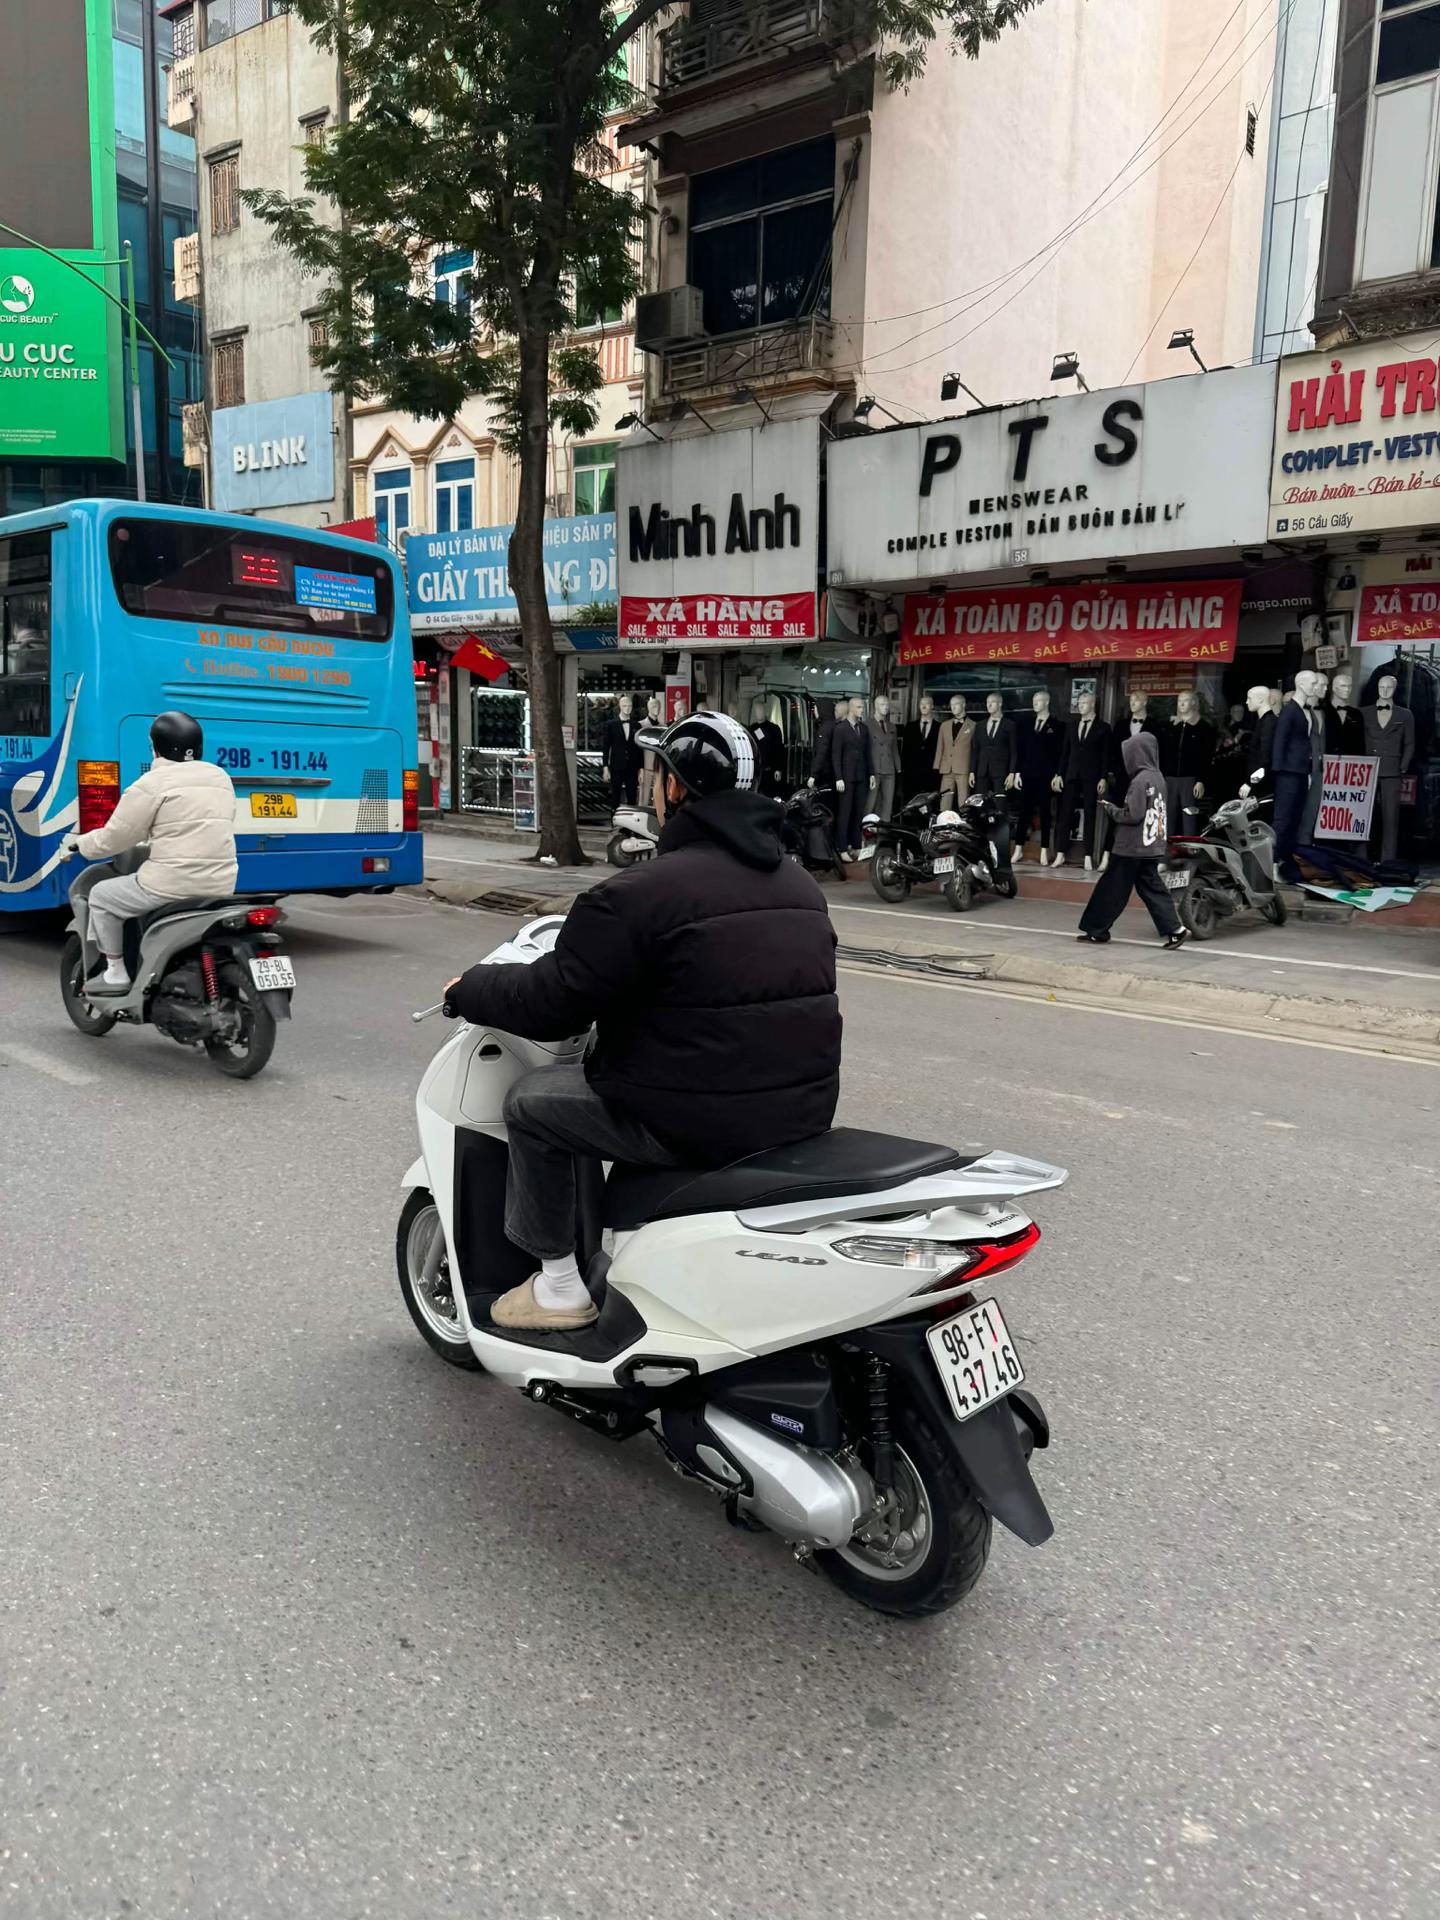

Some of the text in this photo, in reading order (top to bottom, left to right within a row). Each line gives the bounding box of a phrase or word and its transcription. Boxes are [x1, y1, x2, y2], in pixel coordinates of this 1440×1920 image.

[23, 343, 75, 364] CUC
[43, 368, 97, 380] CENTER
[1287, 356, 1440, 432] HẢI TR
[233, 435, 307, 474] BLINK
[969, 484, 1089, 515] MENSWEAR
[1283, 486, 1318, 504] Bán
[1319, 483, 1356, 501] buôn
[1367, 476, 1405, 495] Bán
[573, 520, 600, 543] SẢN
[629, 492, 801, 562] Minh Anh
[887, 531, 948, 553] COMPLE
[956, 522, 1013, 546] VESTON
[1027, 513, 1060, 536] BÁN
[1121, 502, 1156, 526] BÁN
[1292, 512, 1354, 531] 56 Cầu Giấy
[428, 541, 446, 560] ĐẠI
[449, 537, 461, 556] LÝ
[464, 534, 488, 554] BÁN
[490, 531, 505, 551] VÀ
[1014, 550, 1028, 563] 58
[417, 560, 469, 604] GIẦY
[646, 596, 785, 623] XẢ HÀNG
[1372, 587, 1440, 614] XẢ TO
[914, 589, 1224, 638] XẢ TOÀN BỘ CỬA HÀNG
[627, 622, 806, 637] SALE SALE SALE SALE SALE SALE
[1369, 619, 1433, 637] SALE SALE
[903, 641, 1229, 661] SALE SALE SALE SALE SALE SALE SALE
[217, 747, 251, 769] 29B
[271, 749, 328, 771] 191.44
[1343, 762, 1373, 787] VEST
[263, 794, 283, 805] 29B
[1323, 789, 1368, 803] NAM NỮ
[258, 805, 293, 817] 191.44
[257, 972, 295, 988] 050.55
[735, 1249, 829, 1266] LEAD
[941, 1307, 998, 1365] 98-F1
[952, 1344, 1019, 1411] 437.46
